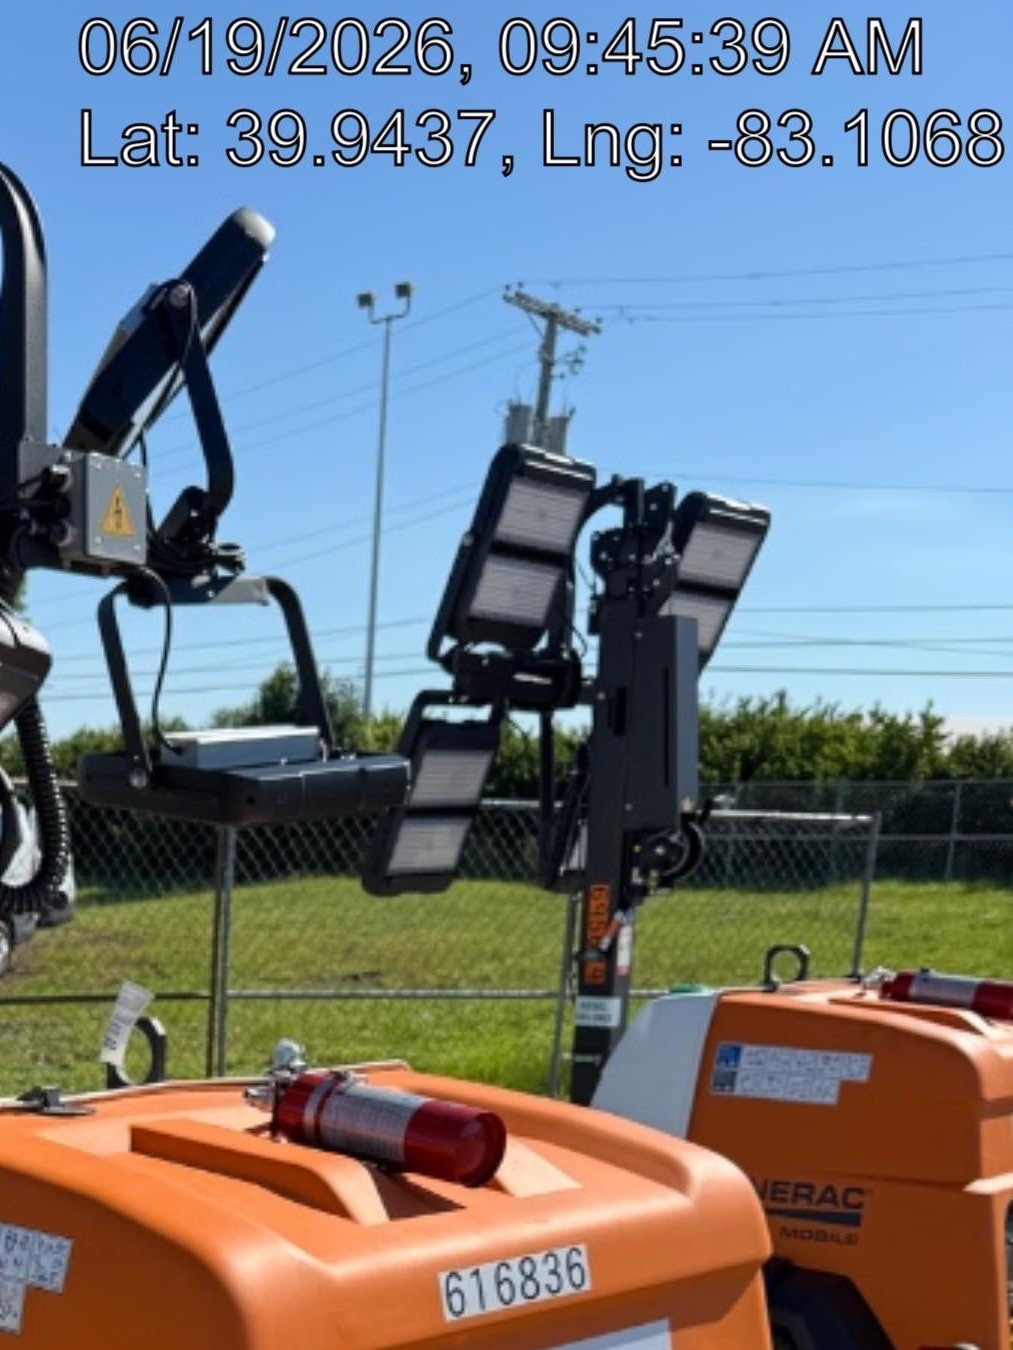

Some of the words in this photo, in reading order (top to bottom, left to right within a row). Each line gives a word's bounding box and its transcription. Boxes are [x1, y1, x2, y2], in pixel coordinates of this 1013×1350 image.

[751, 1180, 865, 1209] NERAC
[779, 1226, 859, 1246] MOBILE
[445, 1247, 585, 1317] 616836
